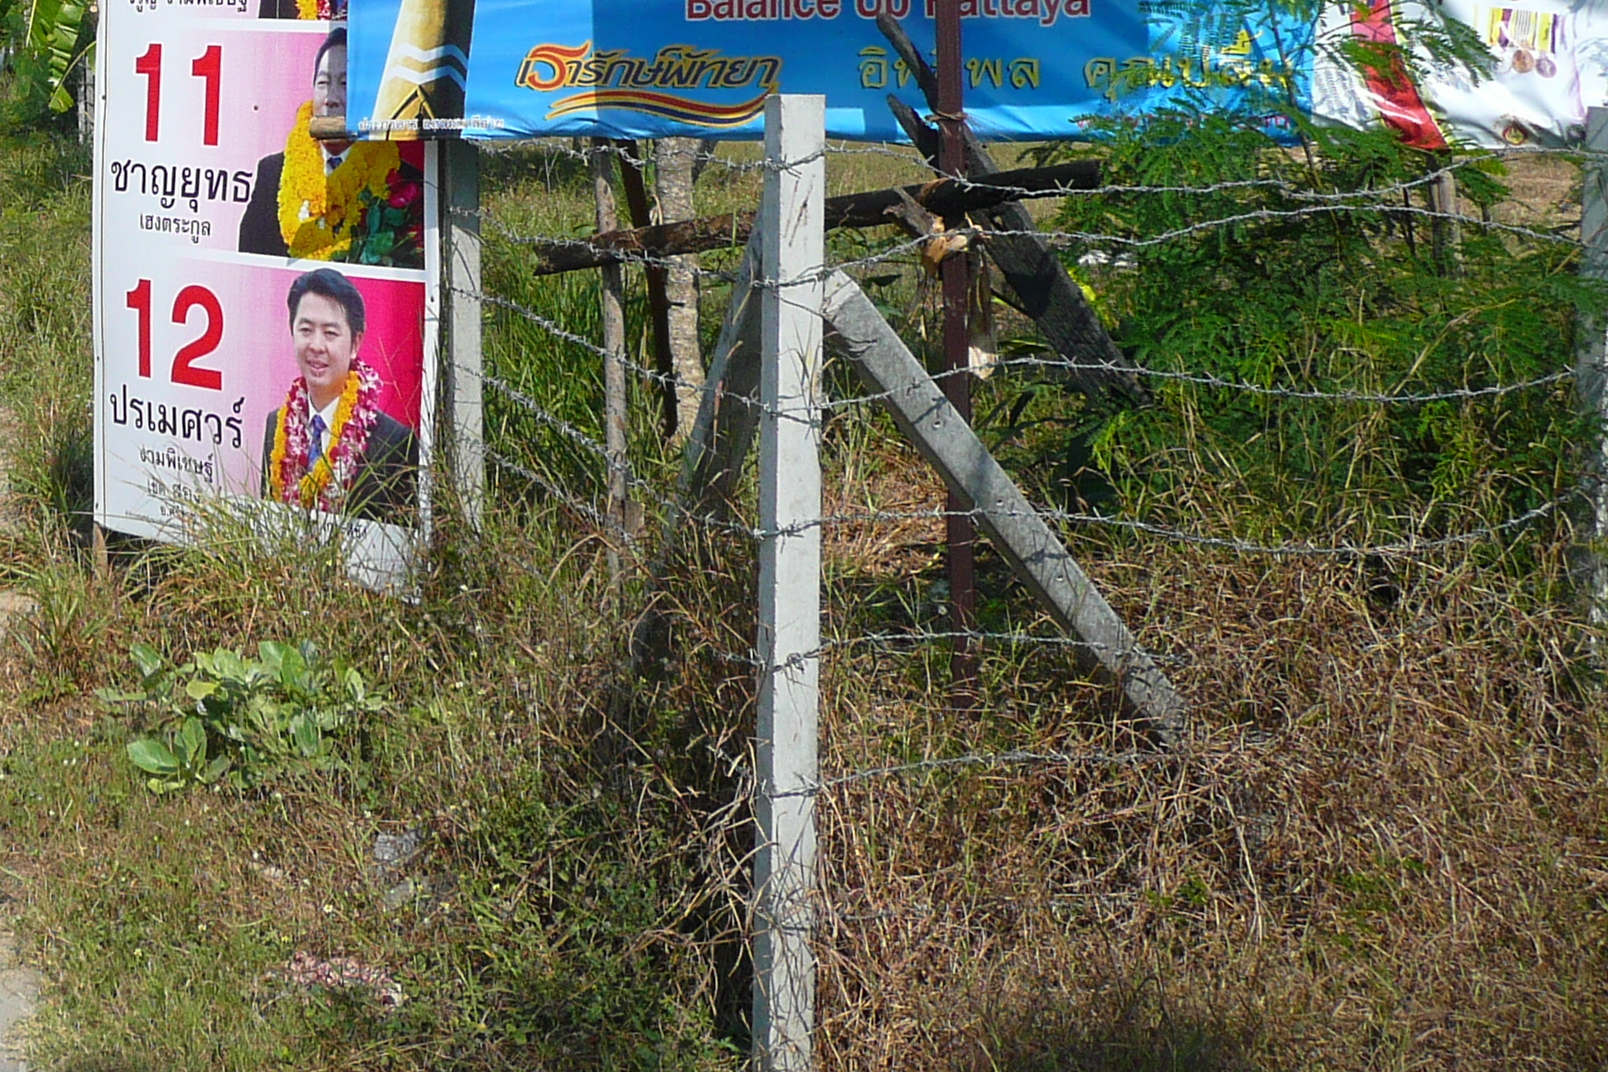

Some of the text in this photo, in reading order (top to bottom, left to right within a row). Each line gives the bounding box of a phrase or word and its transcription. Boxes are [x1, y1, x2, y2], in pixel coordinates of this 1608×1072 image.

[135, 43, 222, 146] 11
[110, 159, 253, 213] ชาญยุทธ
[126, 278, 224, 391] 12
[109, 384, 245, 449] ปรเมศวร์
